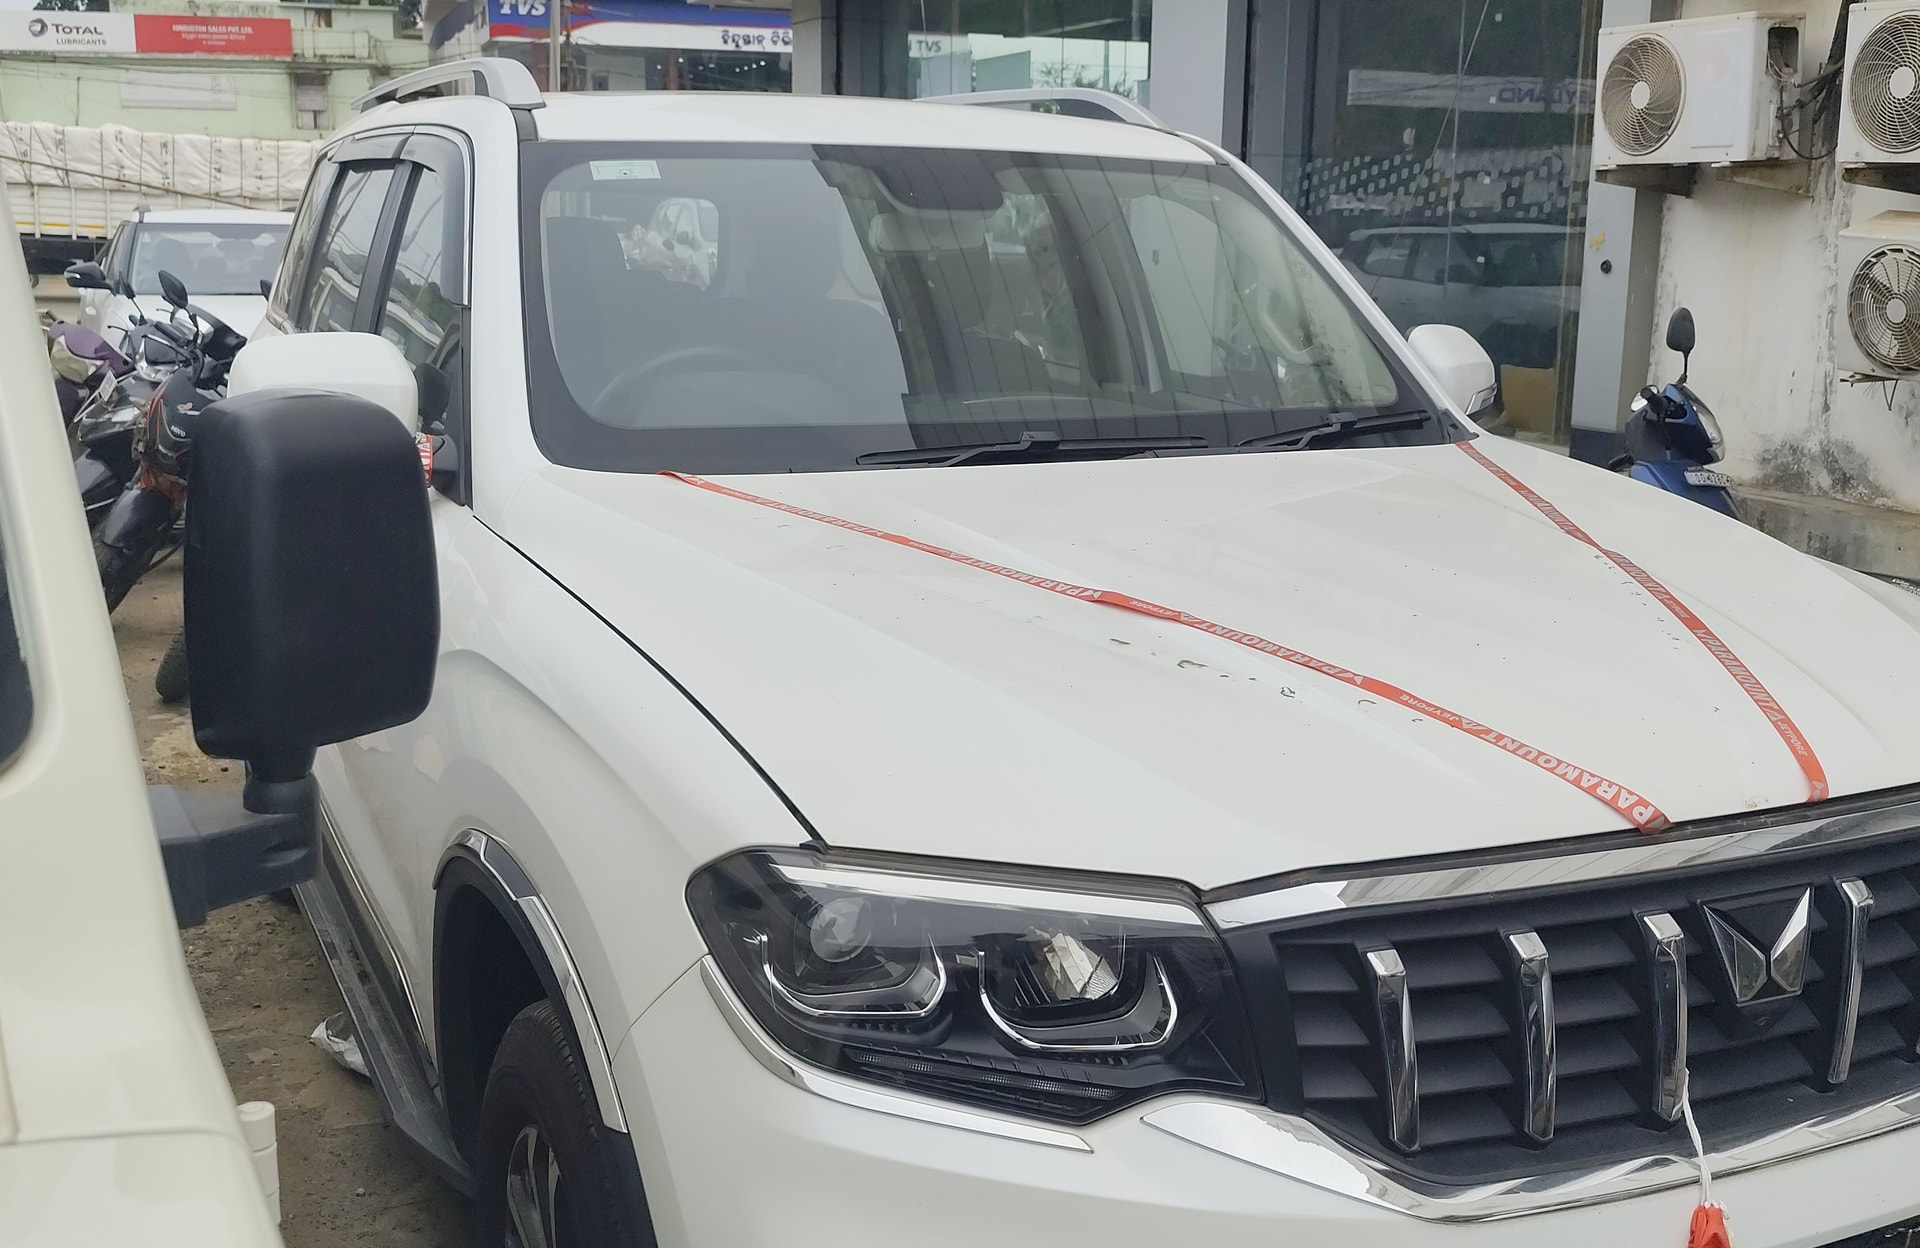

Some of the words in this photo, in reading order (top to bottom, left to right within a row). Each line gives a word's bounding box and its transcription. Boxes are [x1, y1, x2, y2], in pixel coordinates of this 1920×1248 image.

[500, 0, 546, 16] TVS
[56, 38, 107, 46] LUBRICANTS
[916, 40, 942, 52] TVS
[960, 558, 1085, 597] PARAMOUNT
[1129, 600, 1178, 616] JEYPORE
[1194, 621, 1341, 675] PARAMOUNT
[1701, 638, 1780, 709] PARAMOUNT
[1400, 694, 1459, 721] JEYPORE
[1480, 731, 1656, 825] PARAMOUNT
